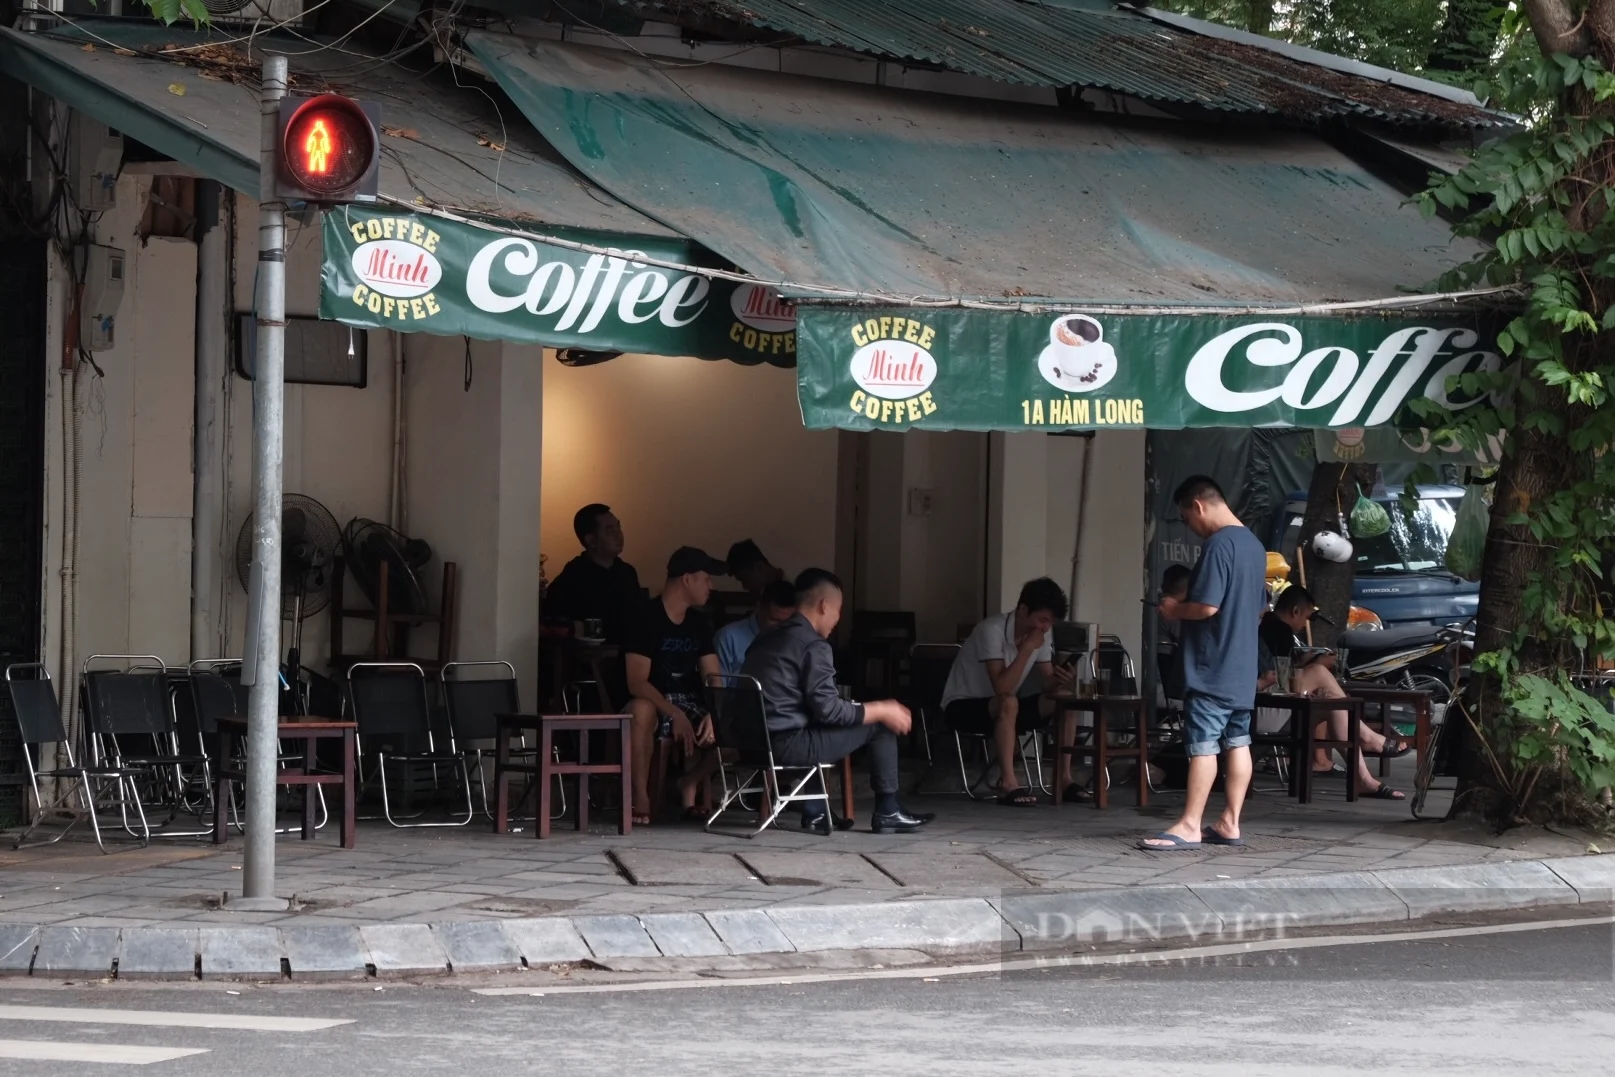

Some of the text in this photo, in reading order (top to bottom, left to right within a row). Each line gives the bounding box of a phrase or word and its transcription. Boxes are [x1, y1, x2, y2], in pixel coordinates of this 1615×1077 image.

[351, 218, 441, 253] COFFEE
[363, 247, 430, 283] Minh
[352, 284, 441, 320] COFFEE
[466, 237, 710, 333] Coffee
[730, 321, 797, 355] COFFE
[851, 316, 936, 350] COFFEE
[863, 349, 925, 382] Minh
[1185, 322, 1516, 427] Coffe
[850, 390, 937, 423] COFFEE
[1021, 394, 1144, 424] 1A HÀM LONG
